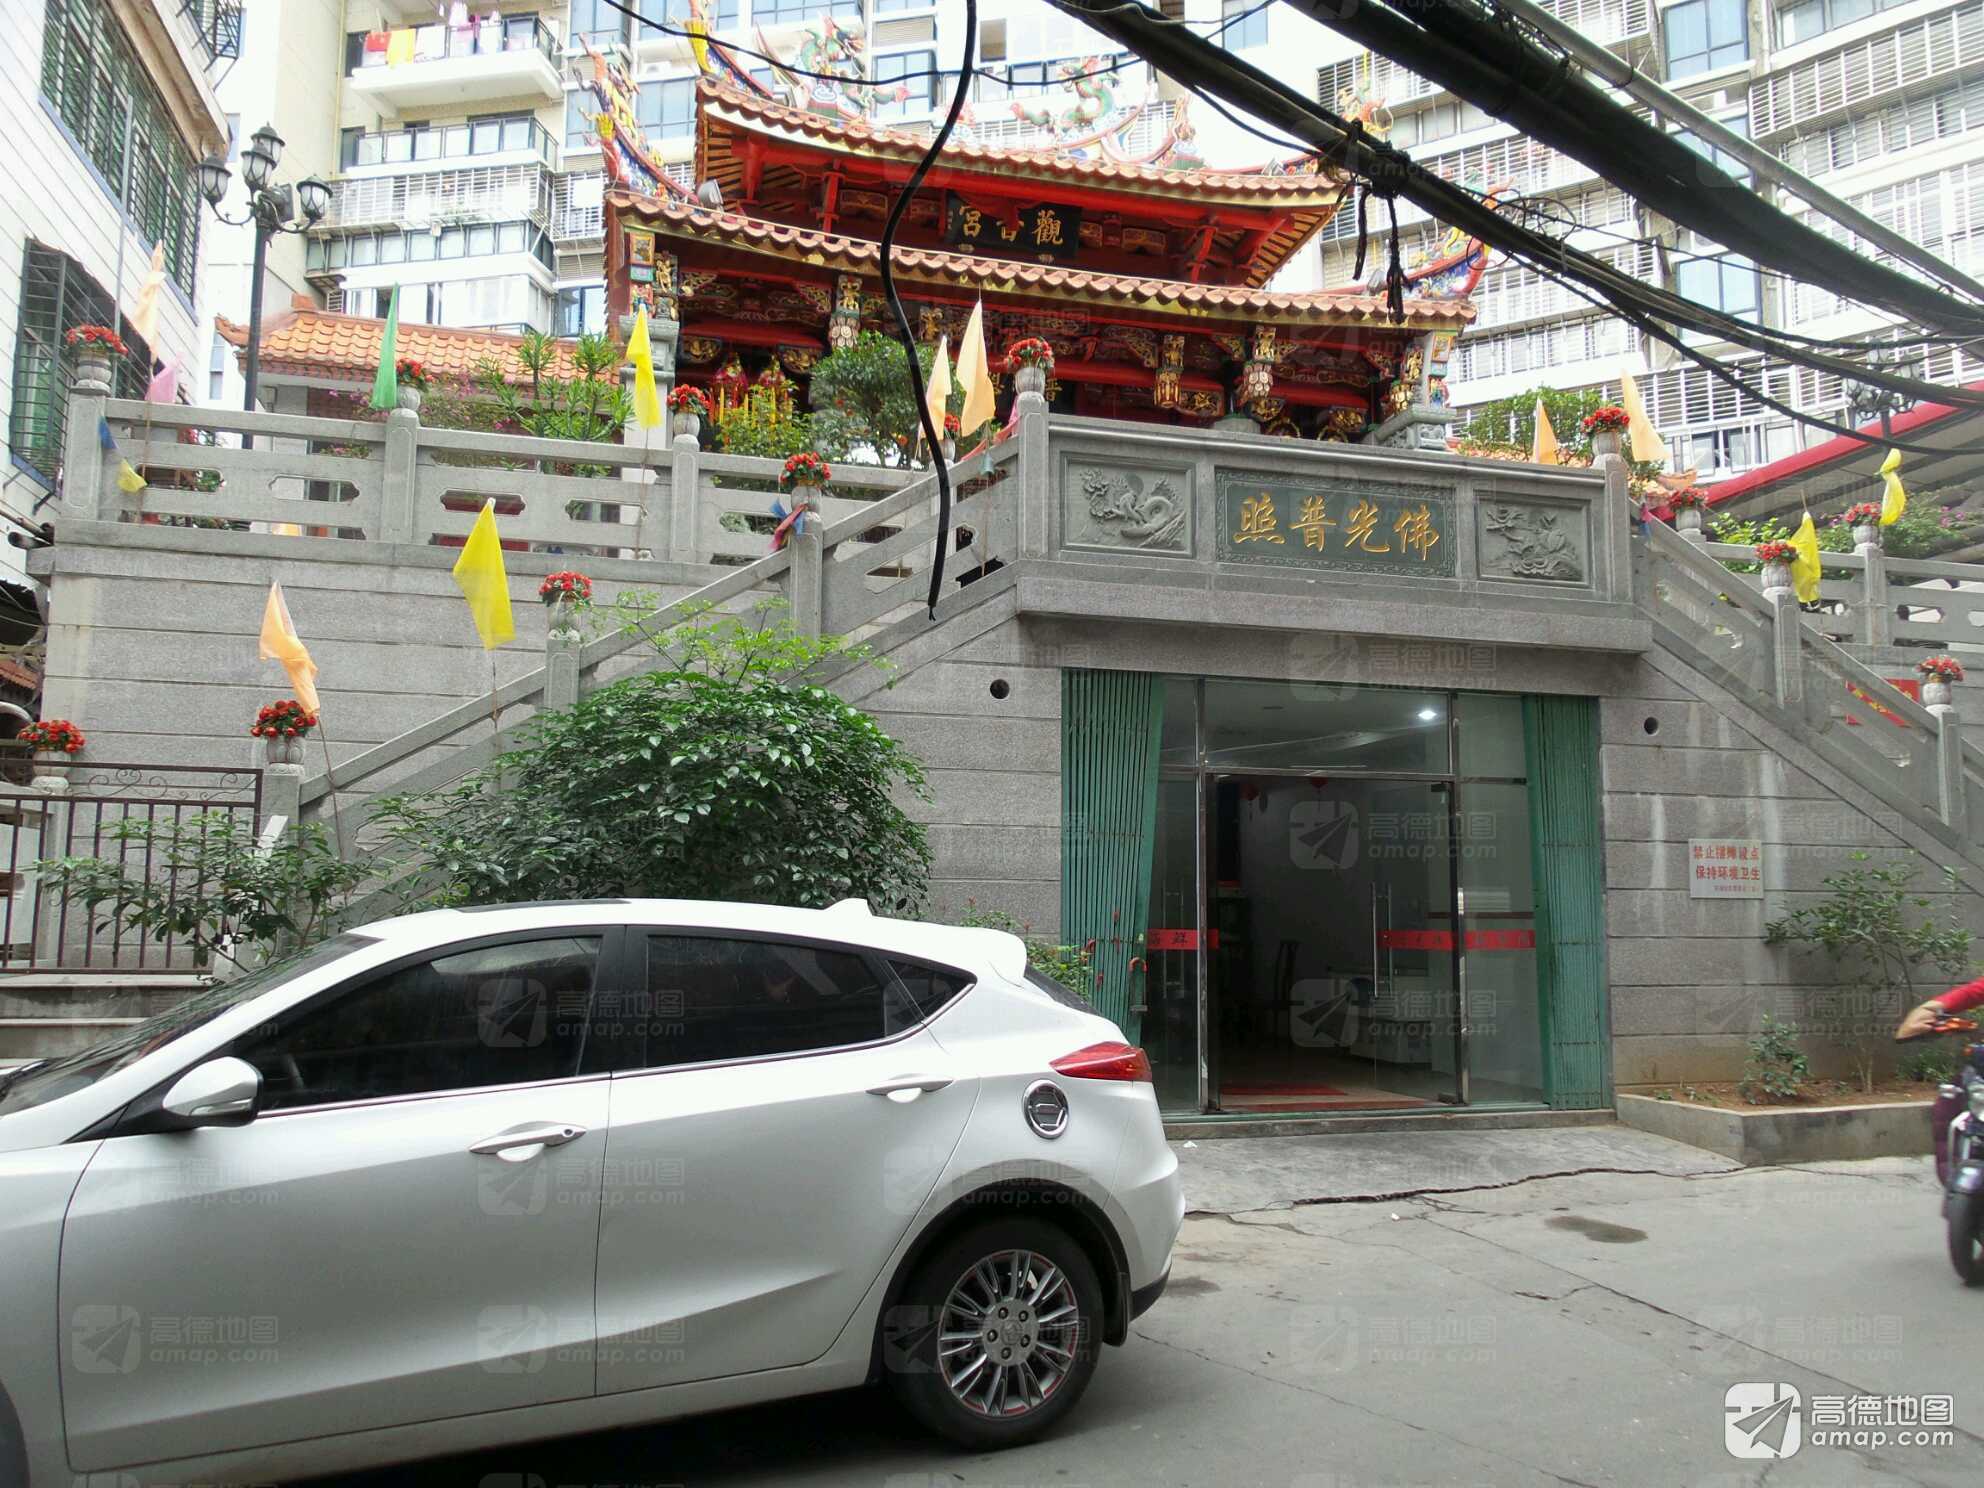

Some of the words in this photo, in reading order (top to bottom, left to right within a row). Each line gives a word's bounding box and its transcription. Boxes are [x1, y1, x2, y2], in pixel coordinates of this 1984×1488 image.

[958, 206, 1063, 246] 觀宮
[1232, 491, 1441, 562] 佛光普照
[1695, 864, 1761, 881] 保持环境卫生
